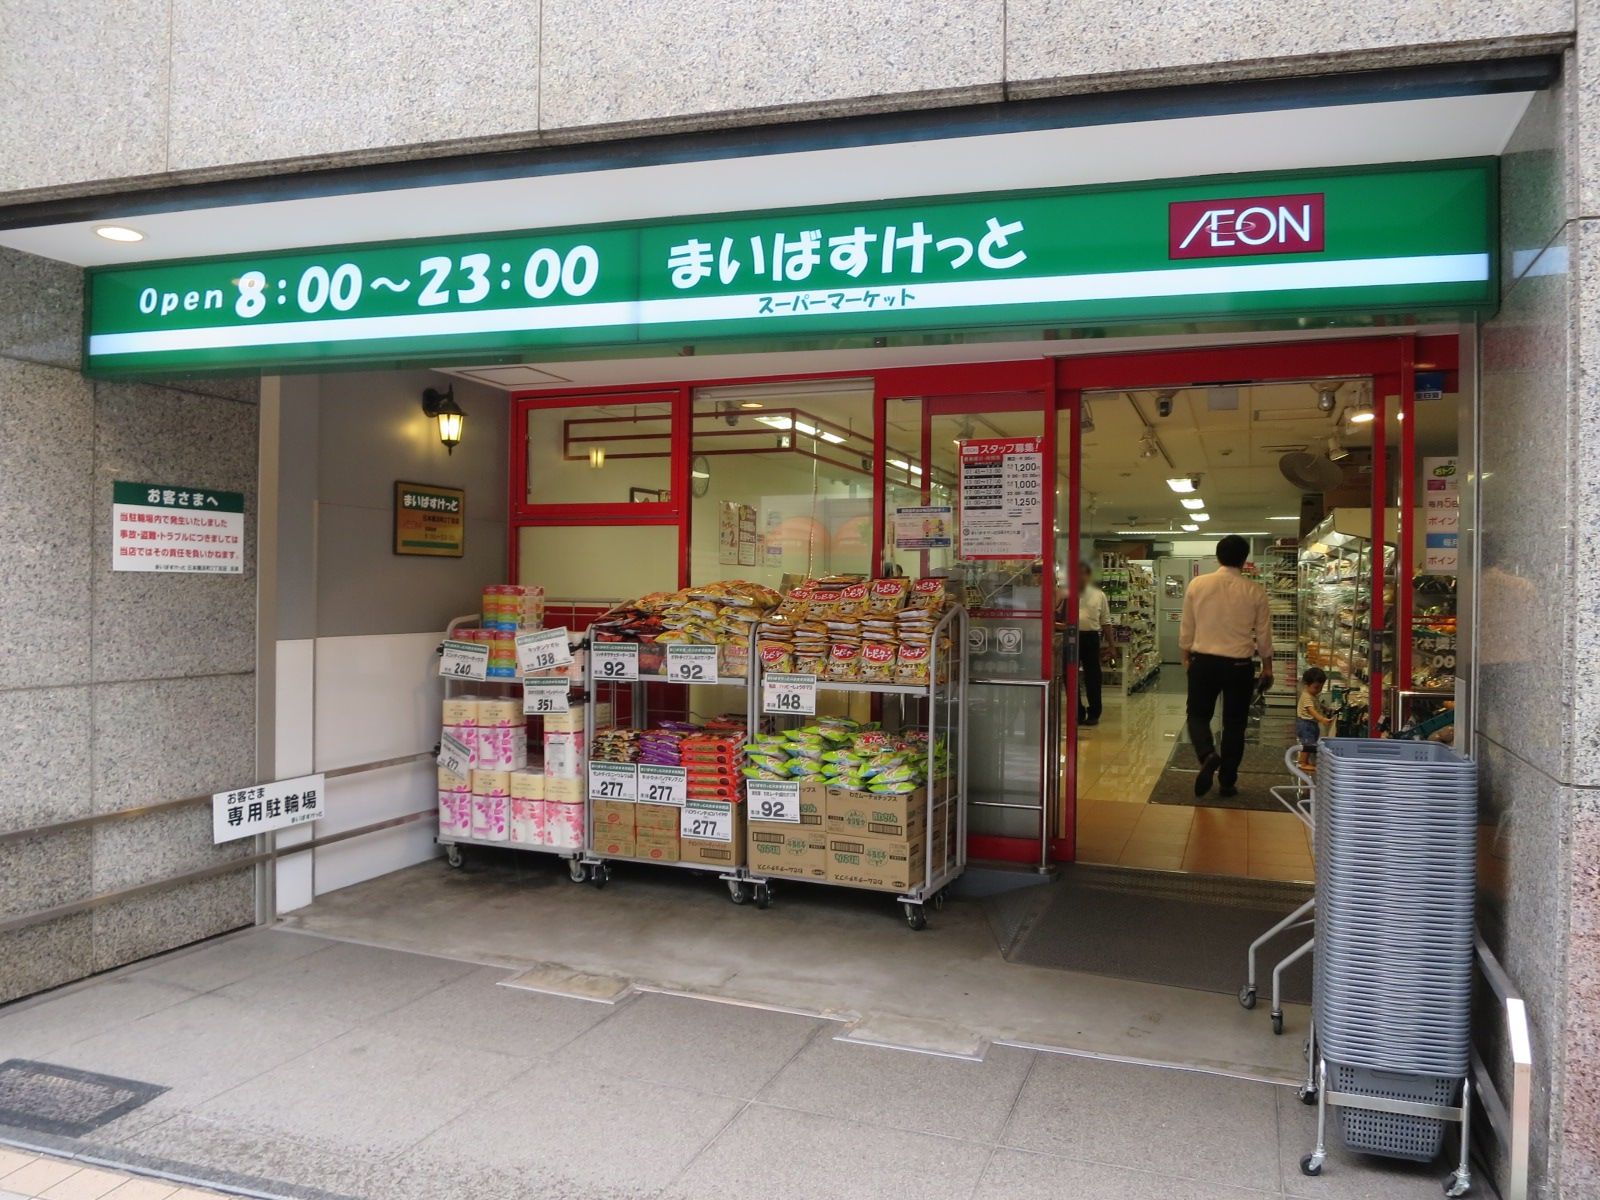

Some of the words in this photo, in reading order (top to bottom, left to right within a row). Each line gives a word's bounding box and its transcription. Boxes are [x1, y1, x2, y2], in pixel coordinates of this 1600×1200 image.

[1179, 204, 1311, 249] AEON
[667, 217, 1028, 289] まいばすけっと
[139, 287, 223, 316] Open
[757, 287, 916, 315] スーパーマーケット
[147, 488, 219, 507] お客さまへ
[403, 494, 459, 511] まいばすけっと
[120, 512, 228, 528] 当駐輪場内で発生いたしました
[454, 663, 471, 675] 240
[604, 661, 625, 676] 92
[680, 664, 703, 679] 92
[537, 699, 553, 711] 351
[776, 694, 800, 709] 148
[227, 787, 265, 805] お客さま
[601, 781, 623, 797] 277
[649, 785, 672, 801] 277
[227, 790, 317, 826] 専用駐輪場
[761, 801, 785, 817] 92
[693, 819, 717, 836] 277
